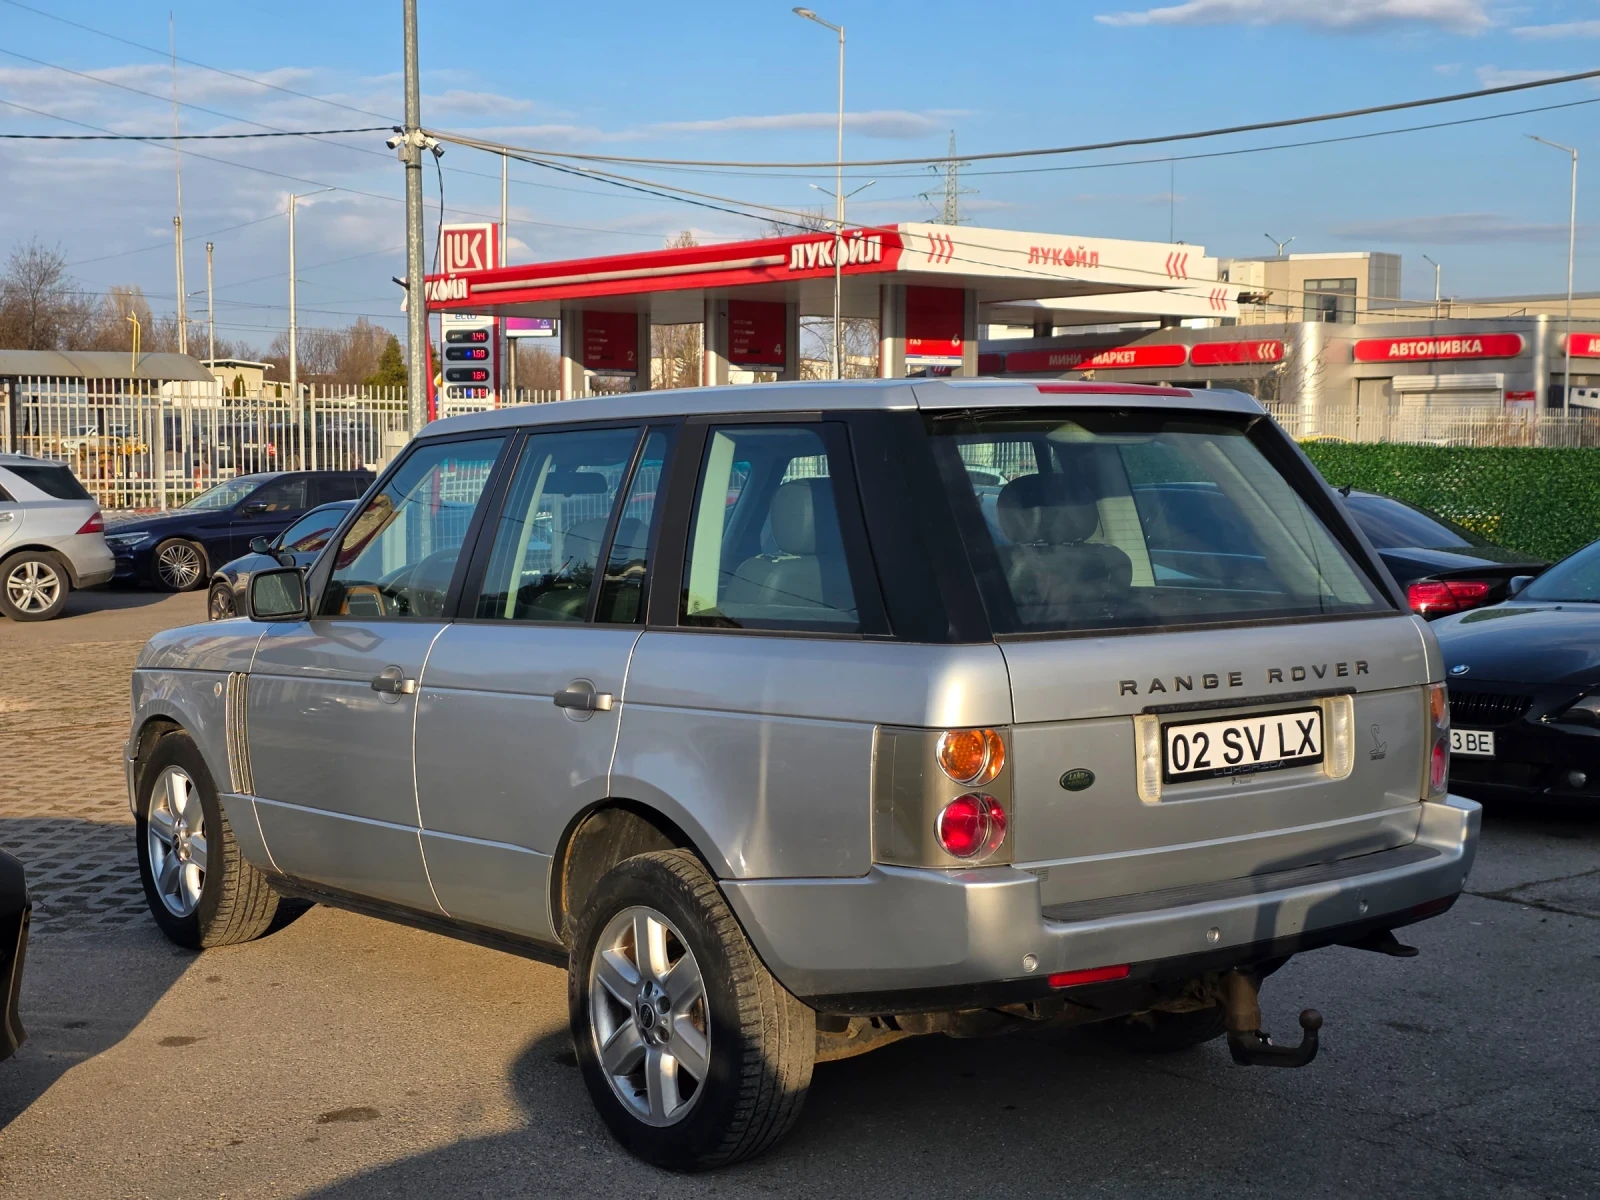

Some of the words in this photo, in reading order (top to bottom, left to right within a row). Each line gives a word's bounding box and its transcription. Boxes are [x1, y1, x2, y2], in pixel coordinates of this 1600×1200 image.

[788, 231, 882, 271] ЛУКОЙЛ
[1027, 245, 1099, 269] ЛУКОЙЛ
[951, 333, 960, 348] 6
[1388, 339, 1483, 357] АВТОМИВКА
[627, 350, 634, 361] 2
[774, 343, 782, 355] 4
[1049, 353, 1081, 365] МИНИ
[1091, 351, 1136, 365] МАРКЕТ
[1118, 671, 1244, 696] RANGE
[1267, 660, 1370, 683] ROVER
[1172, 731, 1211, 772] 02
[1223, 724, 1266, 764] SV
[1277, 717, 1317, 757] LX
[1068, 771, 1085, 781] LAND
